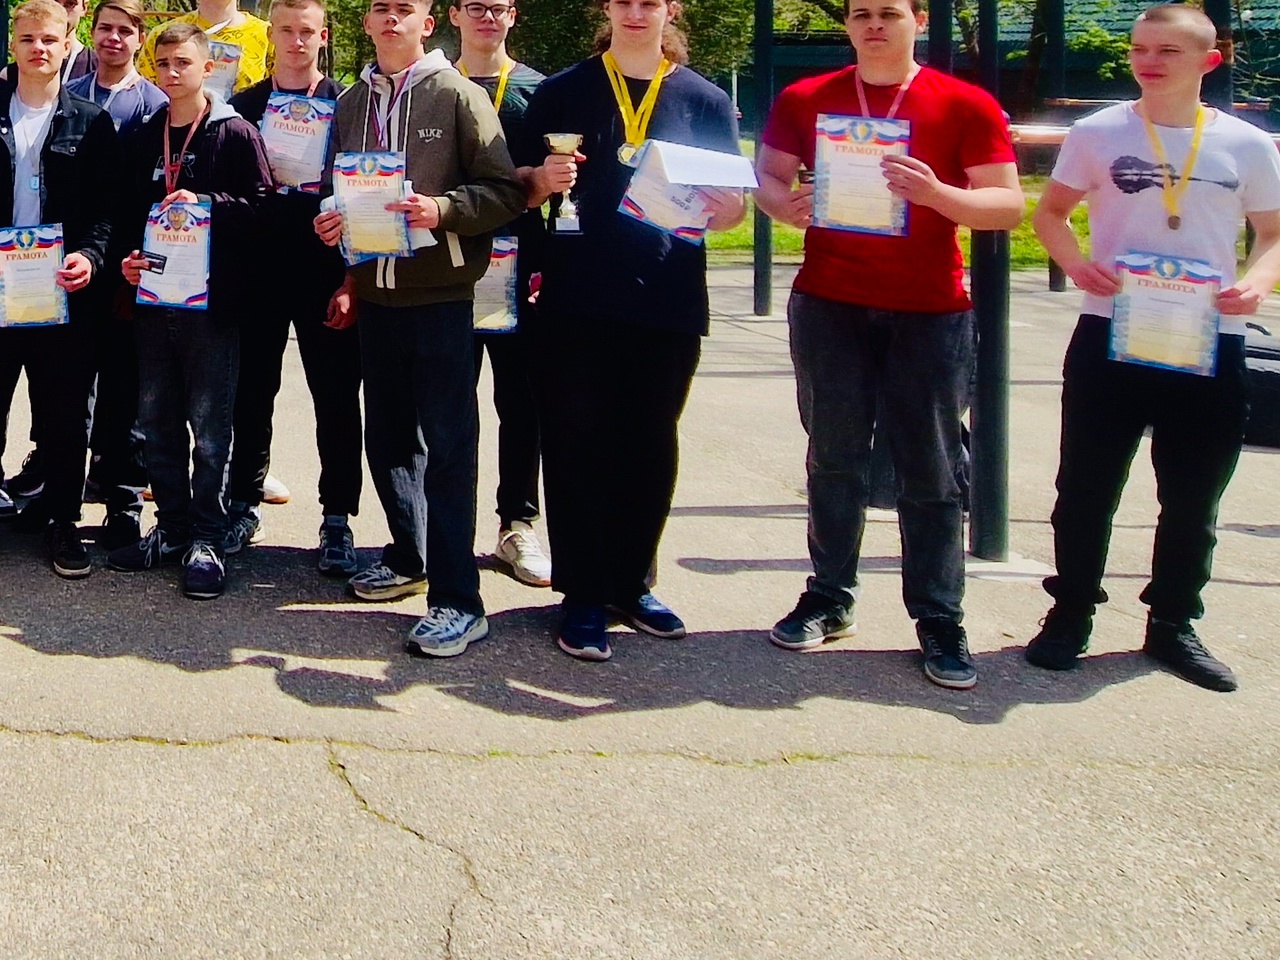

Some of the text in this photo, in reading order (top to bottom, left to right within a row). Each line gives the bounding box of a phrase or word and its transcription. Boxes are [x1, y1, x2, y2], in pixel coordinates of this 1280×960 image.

[273, 120, 317, 136] ГРАМОТА
[417, 128, 443, 139] NIKE
[835, 144, 886, 156] ГРАМОТА
[347, 178, 389, 187] ГРАМОТА
[156, 234, 198, 244] ГРАМОТА
[5, 251, 49, 261] ГРАМОТА
[1137, 278, 1197, 295] ГРАМОТА
